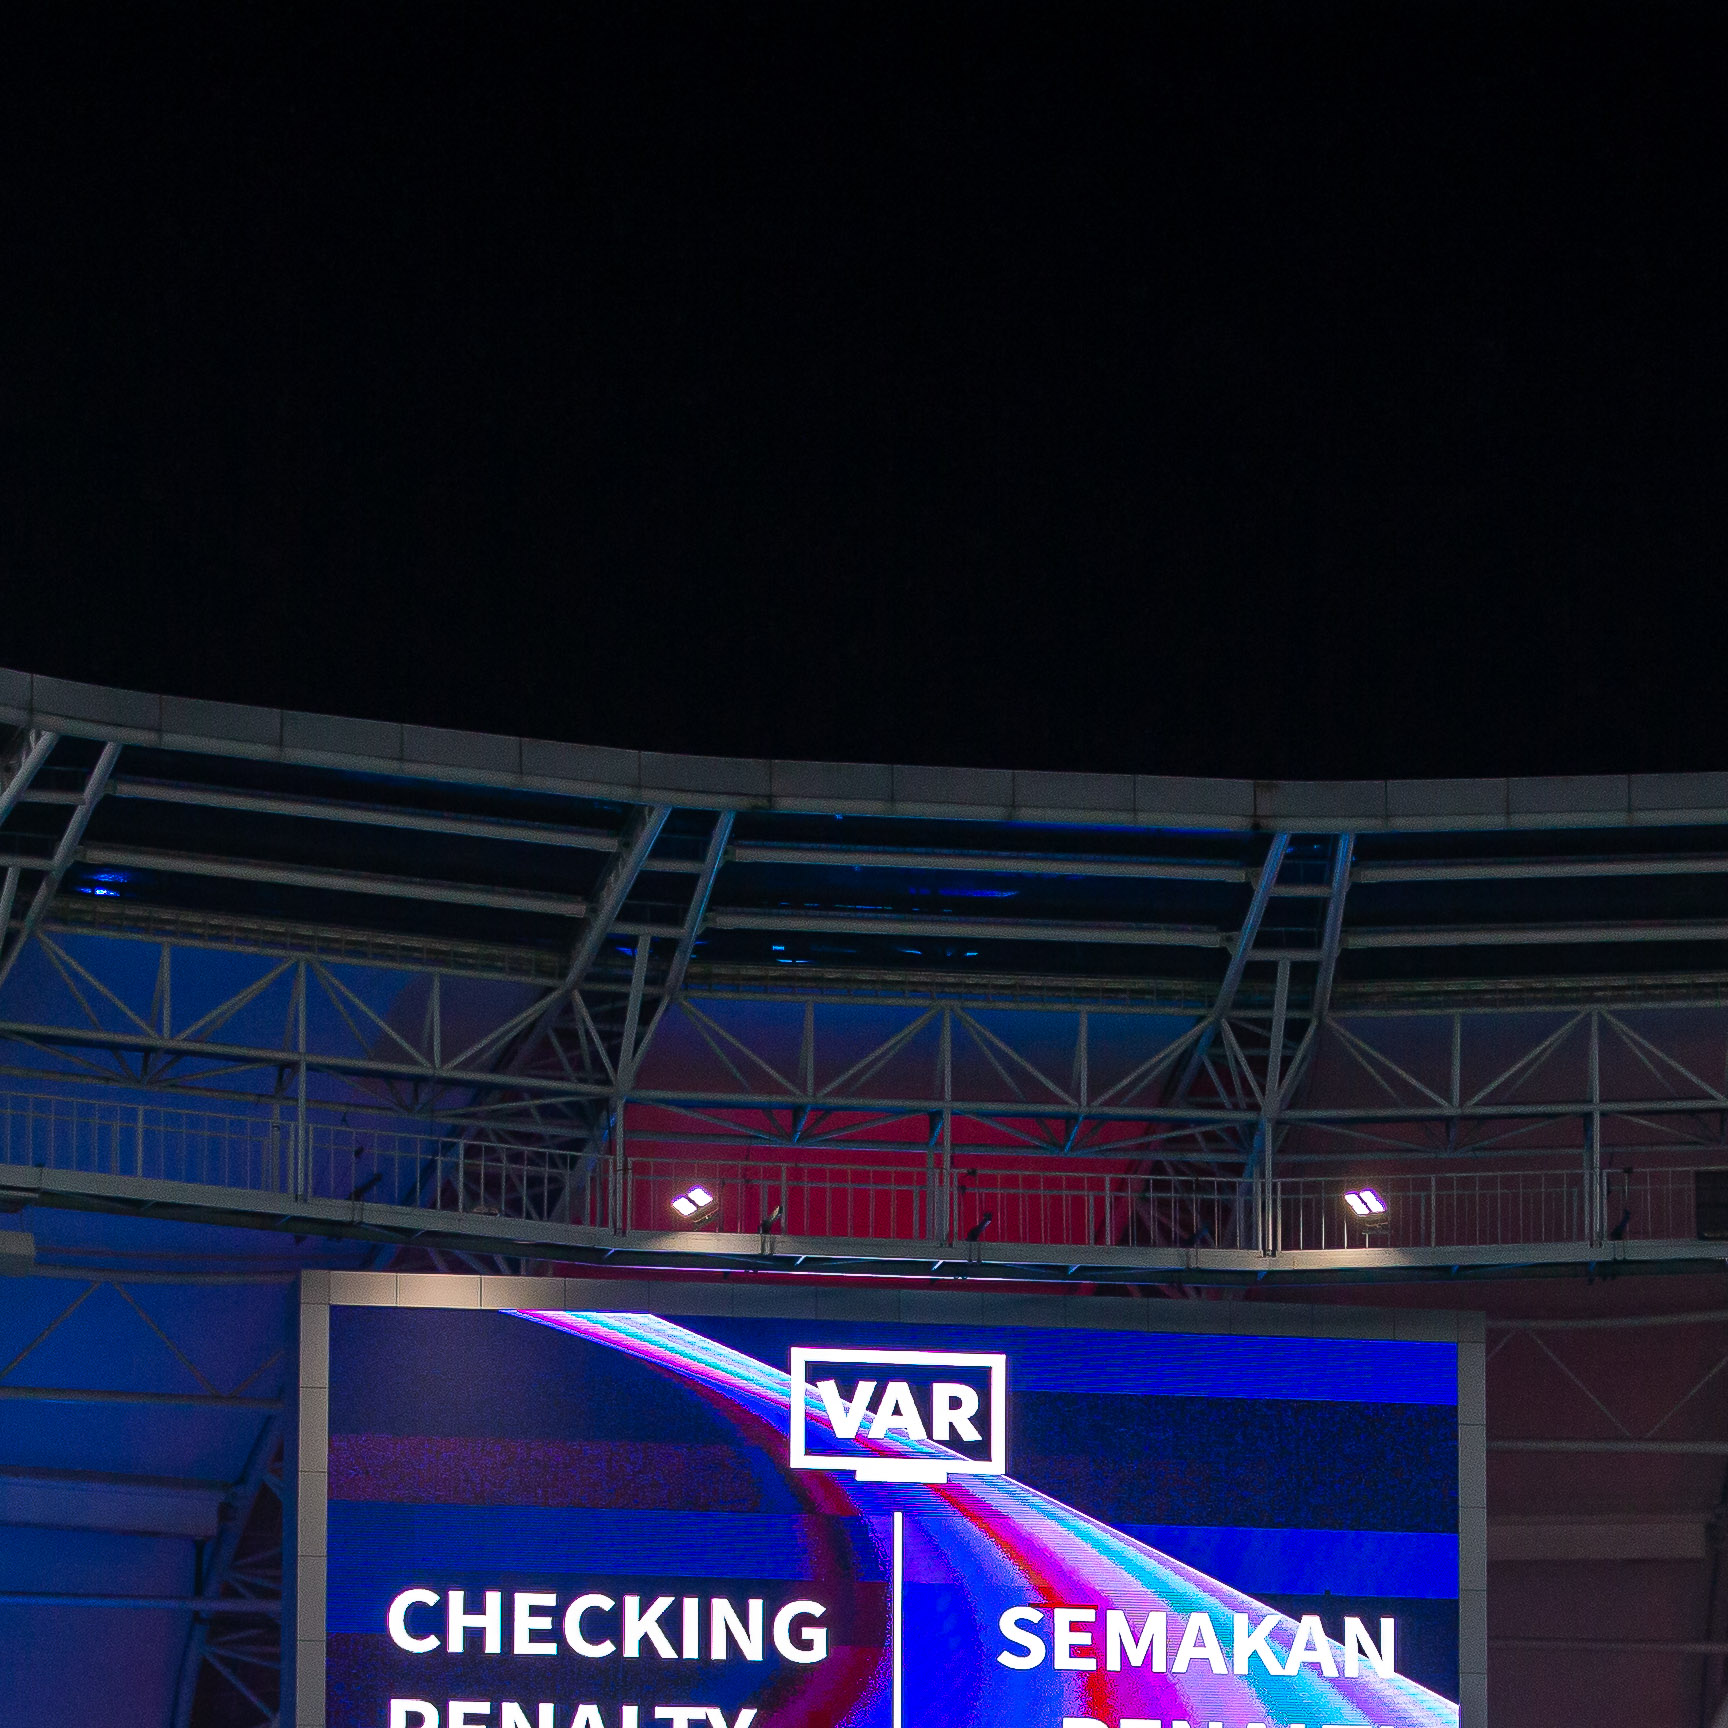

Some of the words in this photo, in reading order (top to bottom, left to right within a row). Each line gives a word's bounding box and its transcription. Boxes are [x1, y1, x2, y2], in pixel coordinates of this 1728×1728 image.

[815, 1379, 982, 1442] VAR
[386, 1588, 830, 1665] CHECKING
[996, 1604, 1398, 1681] SEMAKAN
